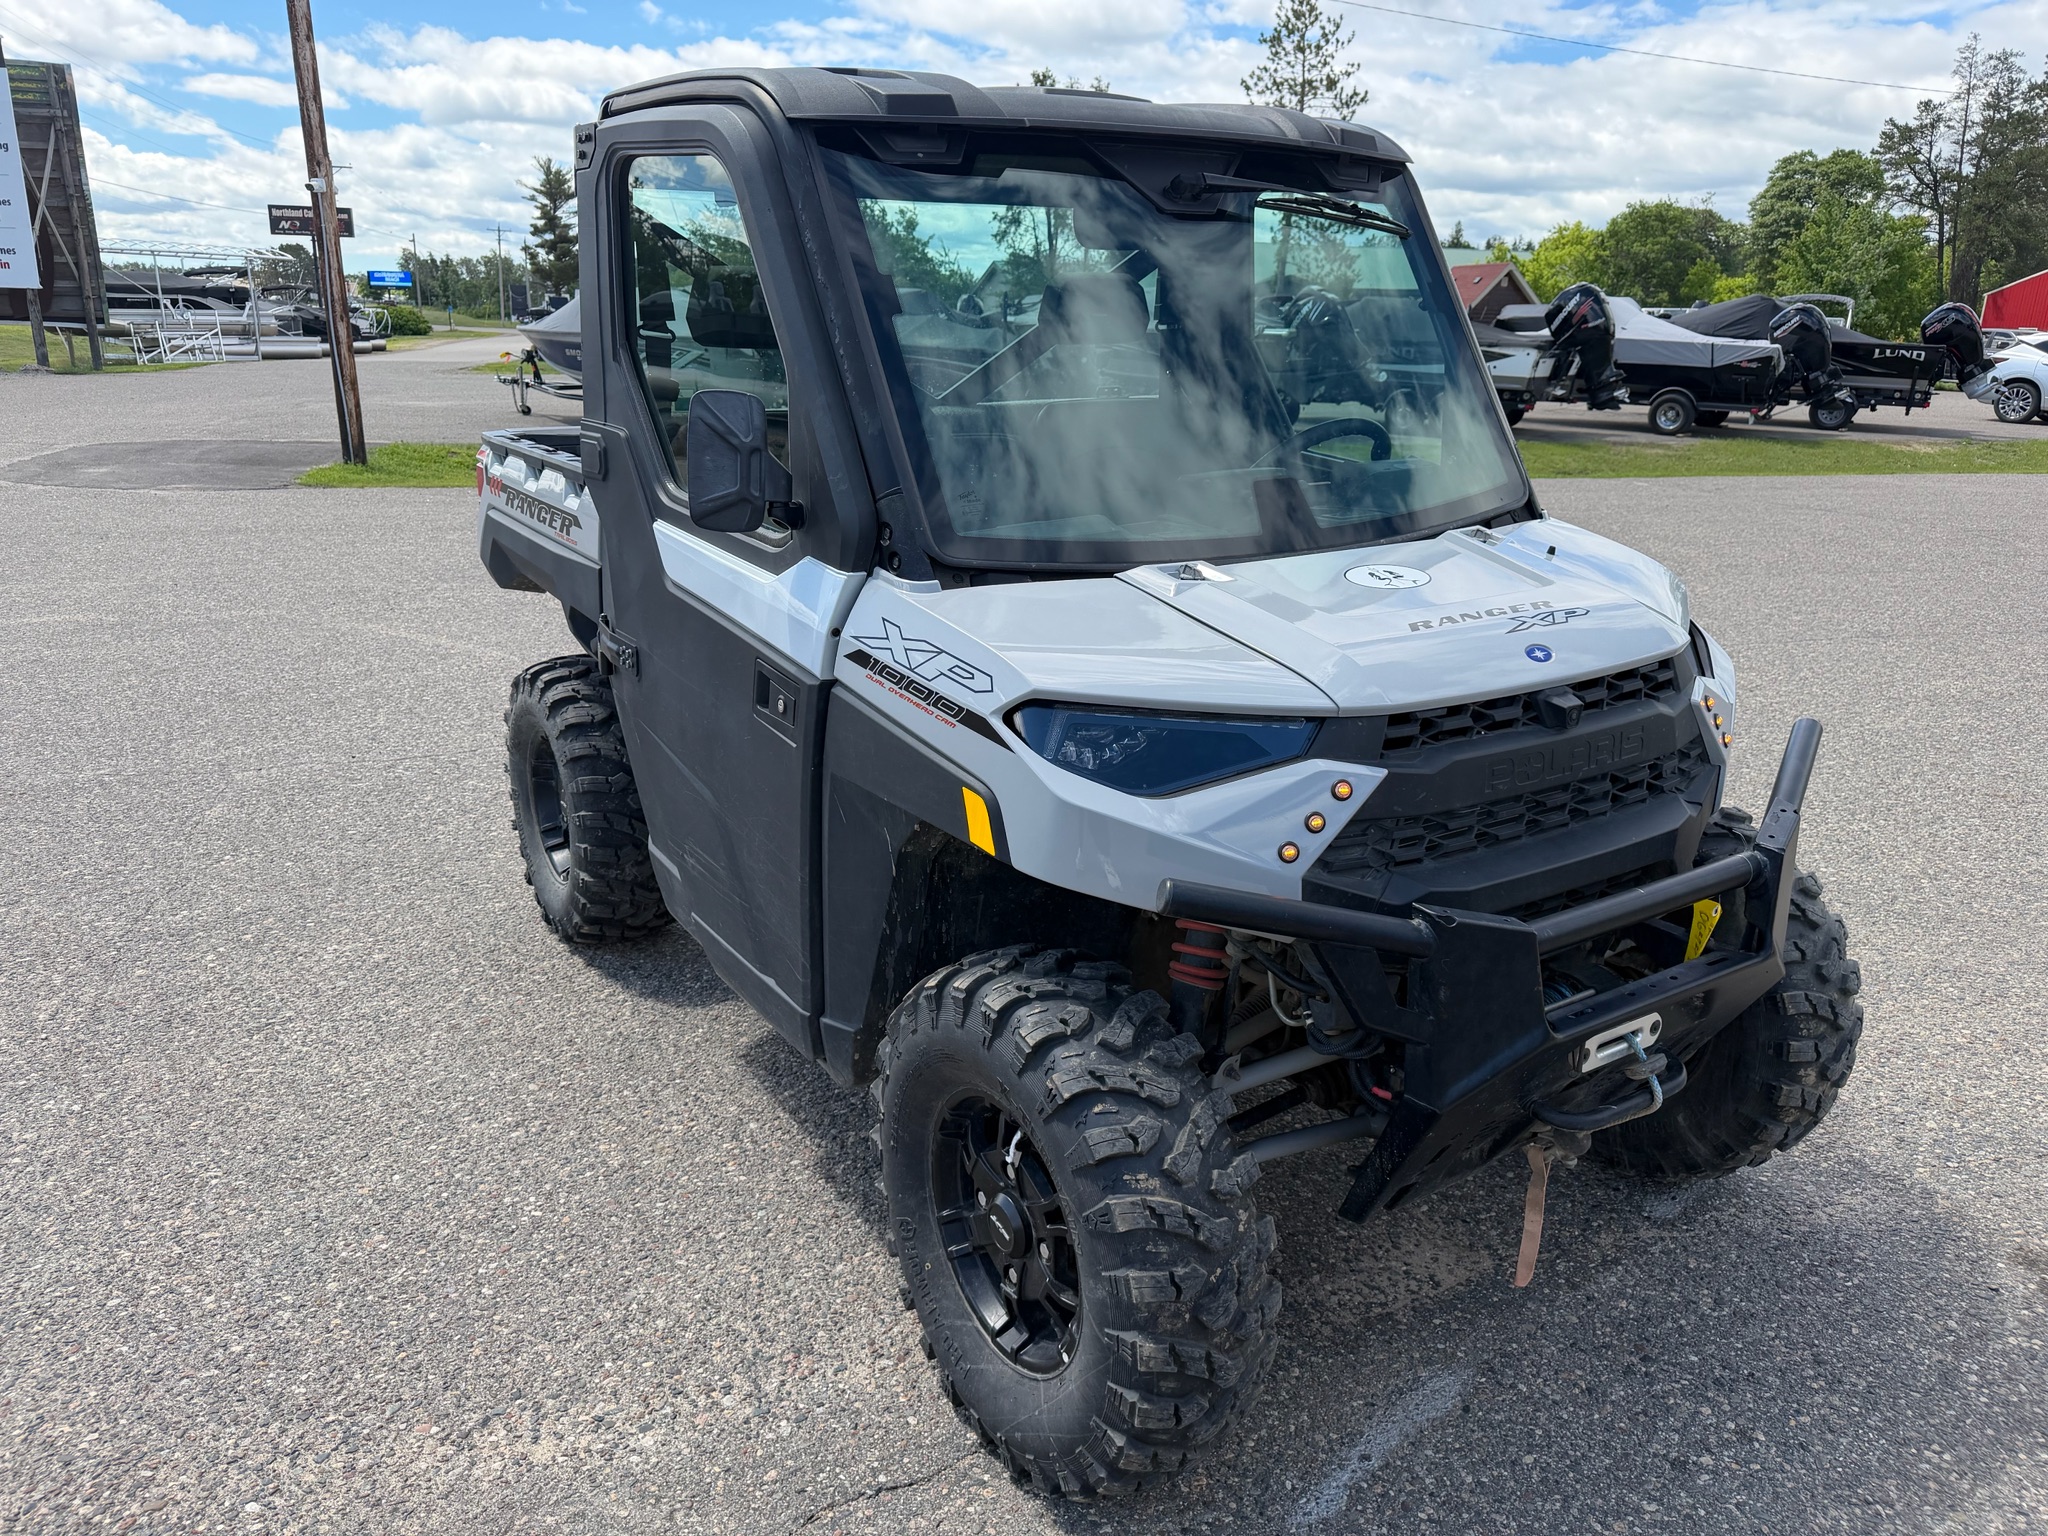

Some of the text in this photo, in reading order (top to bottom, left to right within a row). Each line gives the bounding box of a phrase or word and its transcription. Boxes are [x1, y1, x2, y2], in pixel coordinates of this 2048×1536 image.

[271, 208, 303, 217] Northland
[1550, 292, 1580, 332] MERCURY
[1773, 315, 1800, 338] MERCURY
[1873, 348, 1926, 362] LUND
[505, 488, 575, 537] RANGER
[1408, 600, 1555, 633] RANGER
[1504, 606, 1591, 634] XP
[850, 616, 994, 694] XP
[865, 673, 957, 729] DUAL OVERHEAD CAM
[866, 656, 967, 721] 1000
[1485, 725, 1645, 793] POLARIS
